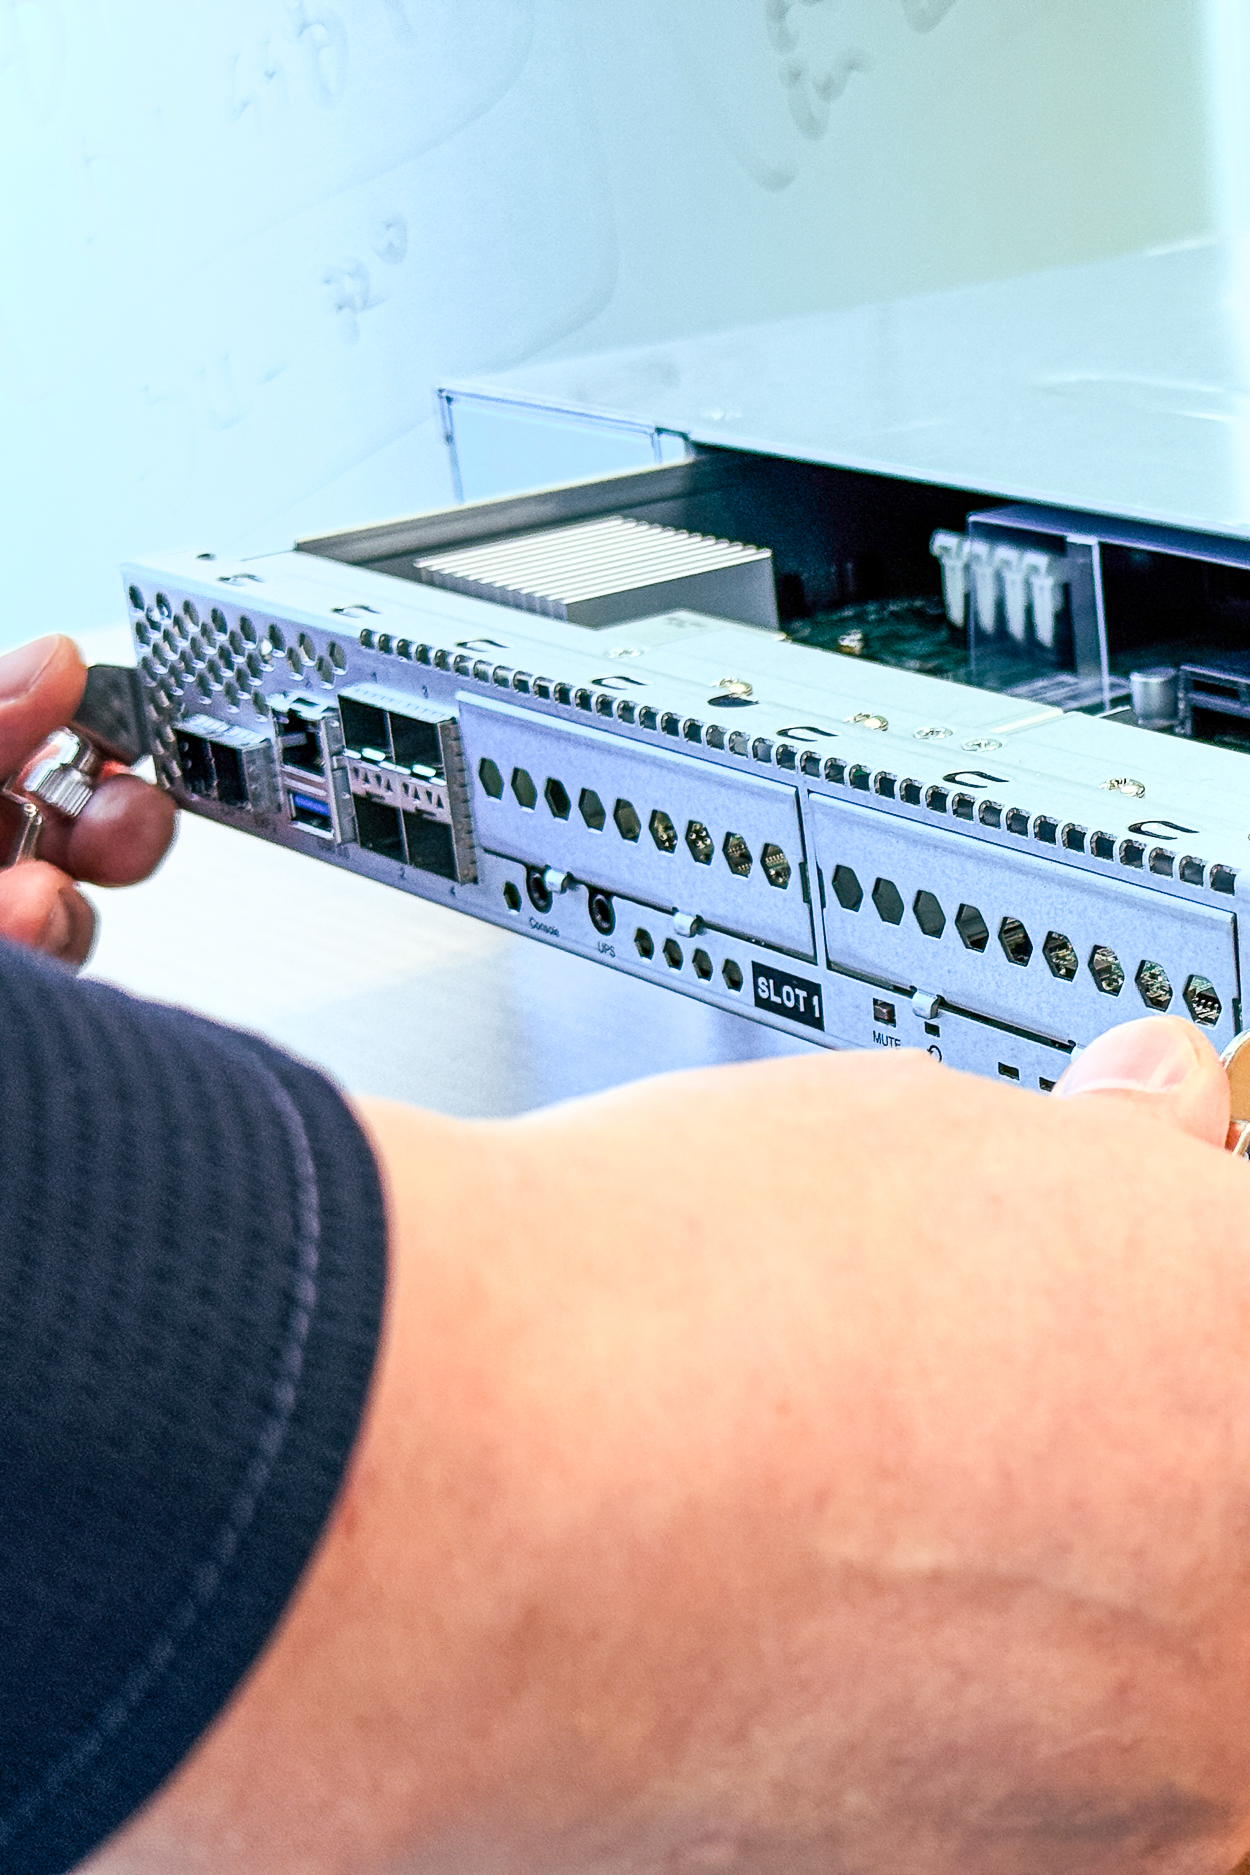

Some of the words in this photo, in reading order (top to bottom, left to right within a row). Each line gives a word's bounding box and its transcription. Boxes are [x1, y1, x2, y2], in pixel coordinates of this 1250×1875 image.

[597, 941, 616, 958] UPS
[757, 976, 808, 1013] SLOT
[812, 995, 821, 1019] 1
